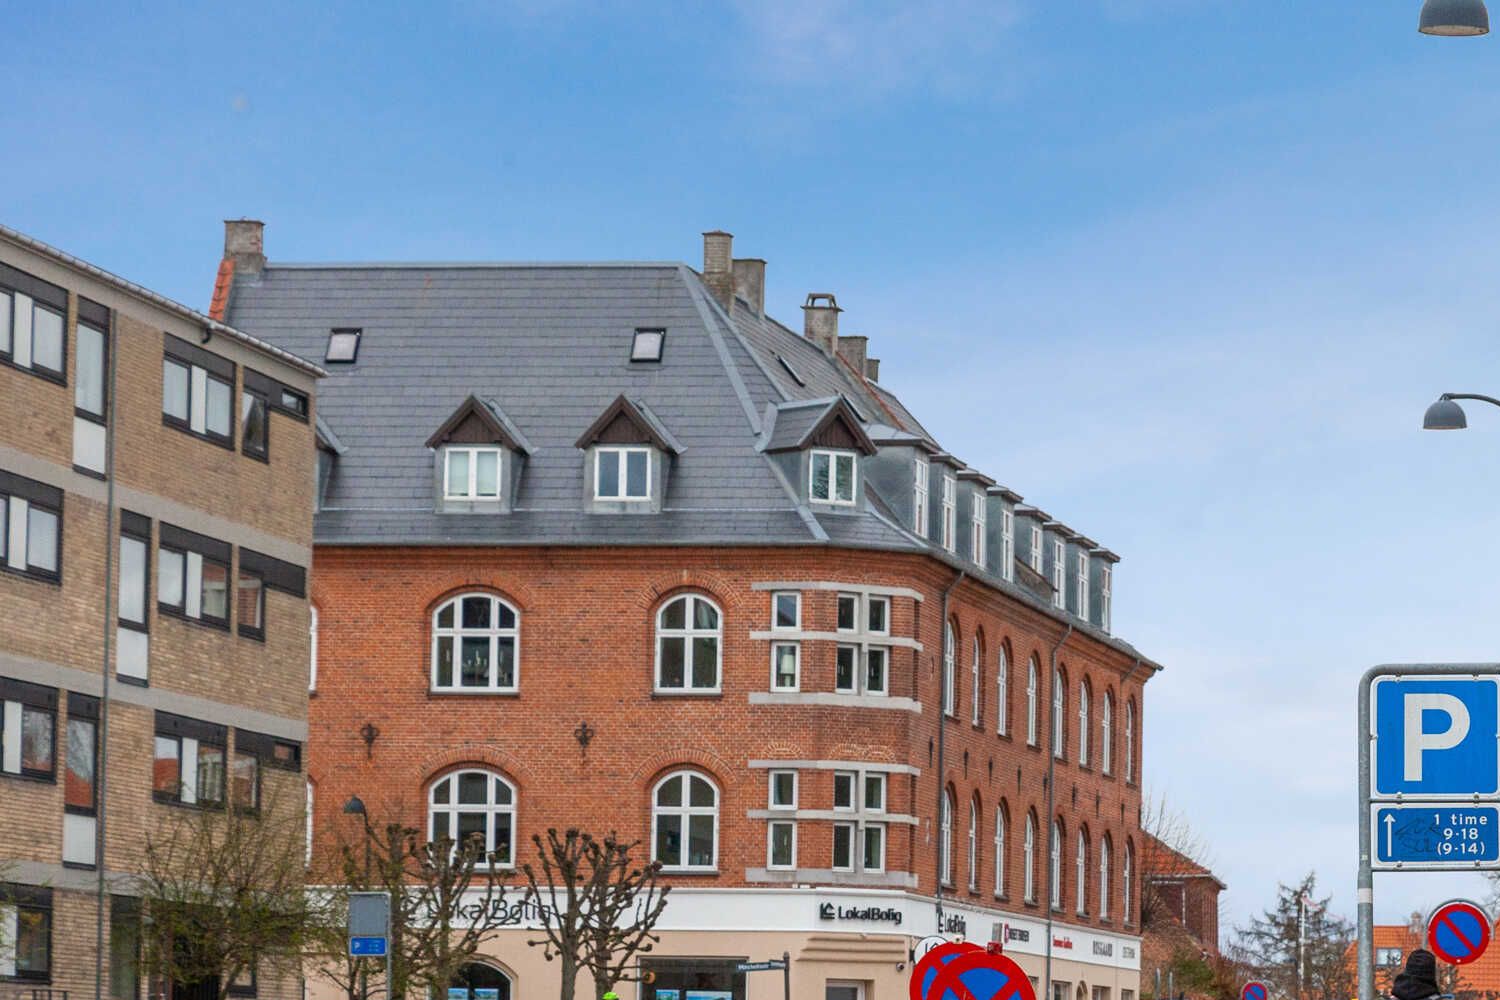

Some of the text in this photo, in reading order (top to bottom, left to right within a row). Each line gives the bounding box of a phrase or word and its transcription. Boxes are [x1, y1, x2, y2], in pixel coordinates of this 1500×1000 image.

[1403, 693, 1471, 782] P
[1434, 813, 1488, 826] 1 time
[1443, 827, 1479, 840] 9-18
[1437, 841, 1485, 856] (9-14)
